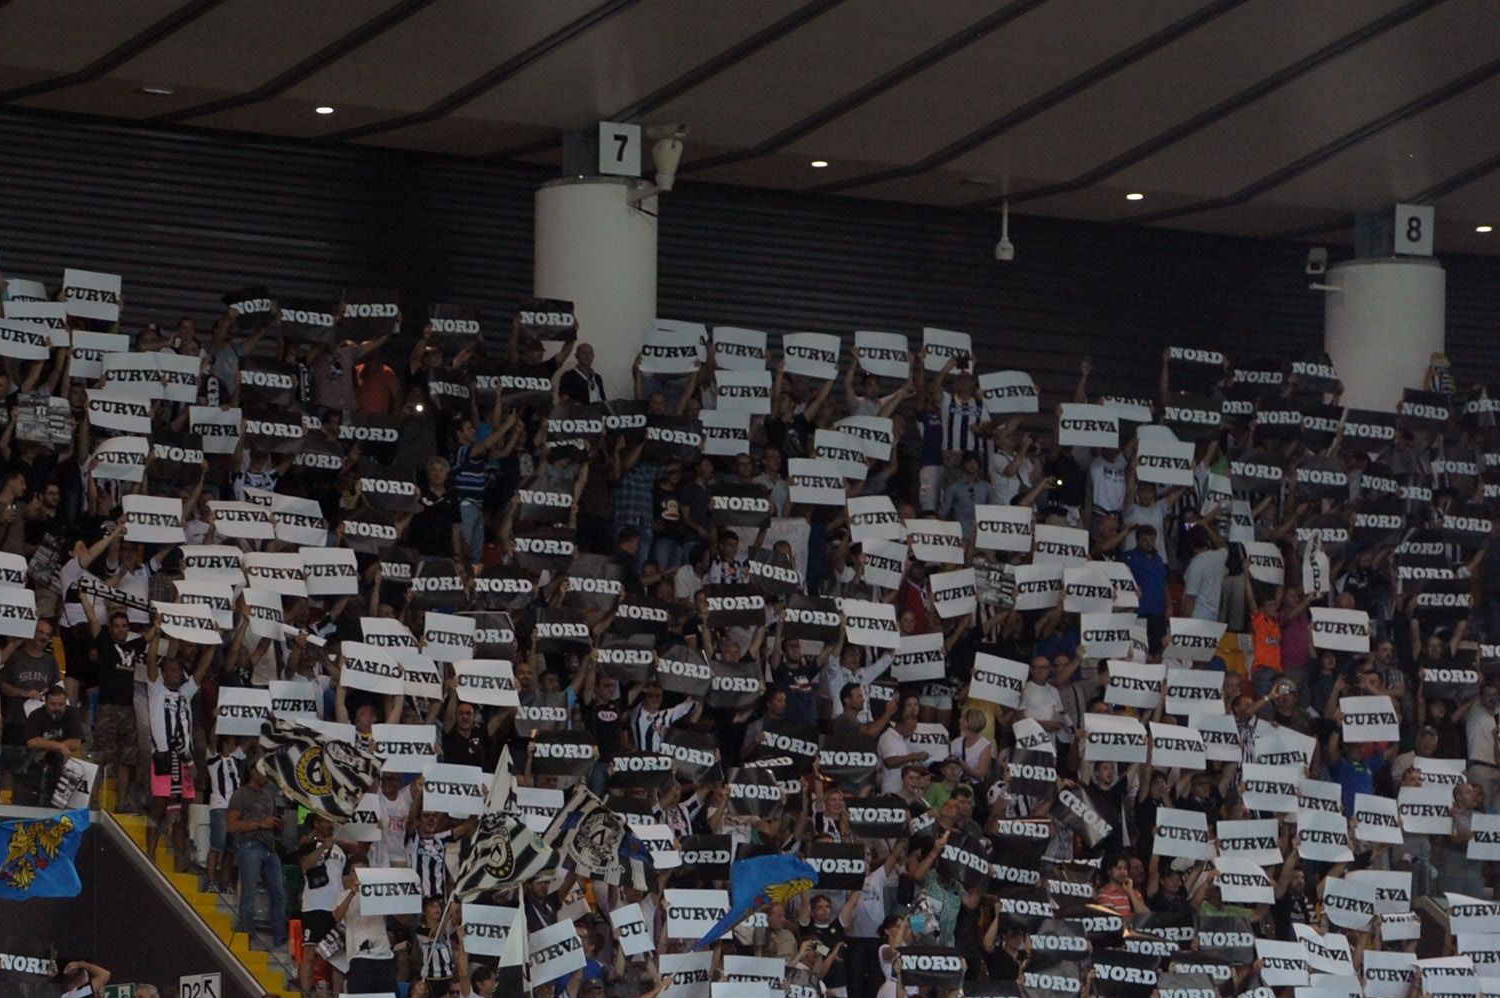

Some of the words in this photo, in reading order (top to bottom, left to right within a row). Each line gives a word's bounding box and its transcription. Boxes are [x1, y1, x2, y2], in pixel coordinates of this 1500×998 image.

[613, 134, 628, 161] 7
[1406, 216, 1421, 242] 8
[281, 309, 333, 326] NORD
[641, 345, 697, 357] CURVA
[786, 346, 835, 363] CURVA
[1170, 347, 1223, 364] NORD
[89, 400, 148, 416] CURVA
[1165, 407, 1221, 424] NORD
[245, 420, 303, 437] NORD
[647, 427, 701, 446] NORD
[1344, 423, 1394, 439] NORD
[343, 521, 397, 539] NORD
[707, 596, 764, 610] NORD
[785, 609, 840, 626] NORD
[847, 616, 898, 631] CURVA
[346, 655, 402, 677] CURVA
[1111, 676, 1161, 692] CURVA
[1424, 669, 1478, 682] NORD
[376, 738, 433, 756] CURVA
[613, 757, 673, 771] NORD
[425, 782, 482, 797] CURVA
[1220, 836, 1275, 850] CURVA
[1094, 964, 1157, 984] NORD
